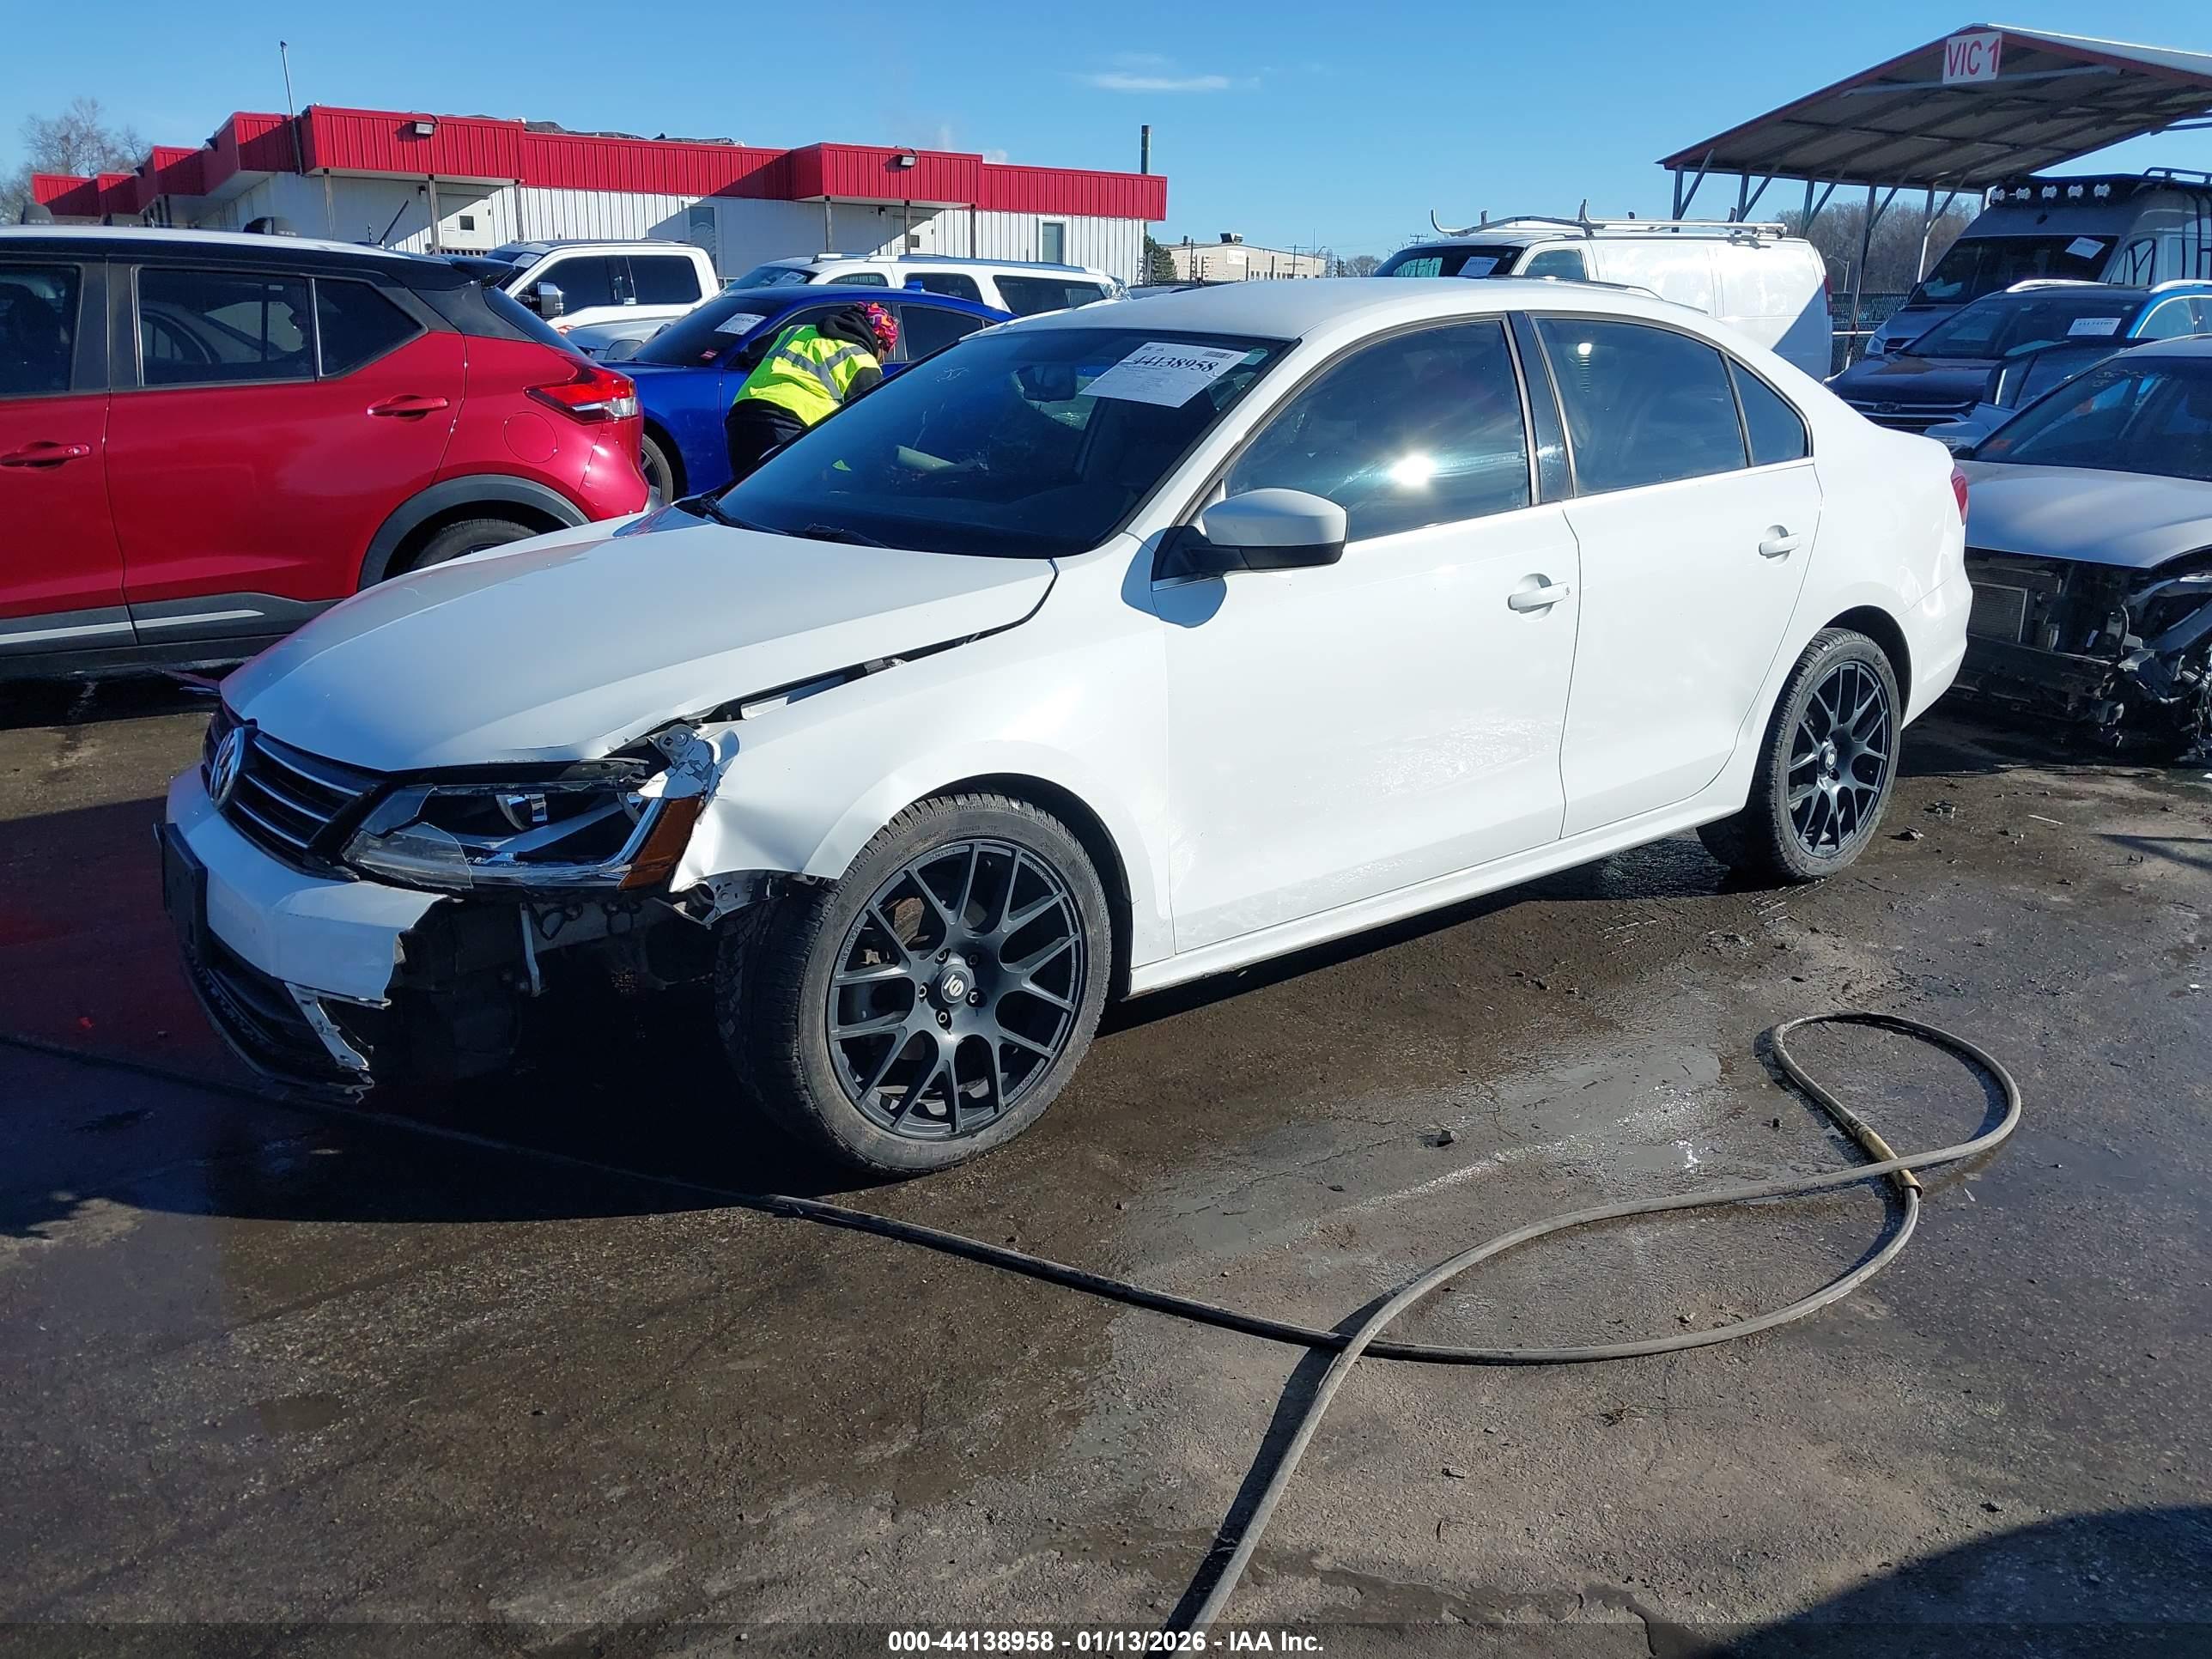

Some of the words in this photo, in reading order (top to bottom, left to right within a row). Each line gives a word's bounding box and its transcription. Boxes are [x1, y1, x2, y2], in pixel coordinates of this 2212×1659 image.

[1948, 40, 1983, 77] VIC
[1987, 38, 2000, 73] 1
[1133, 355, 1219, 373] 44138958
